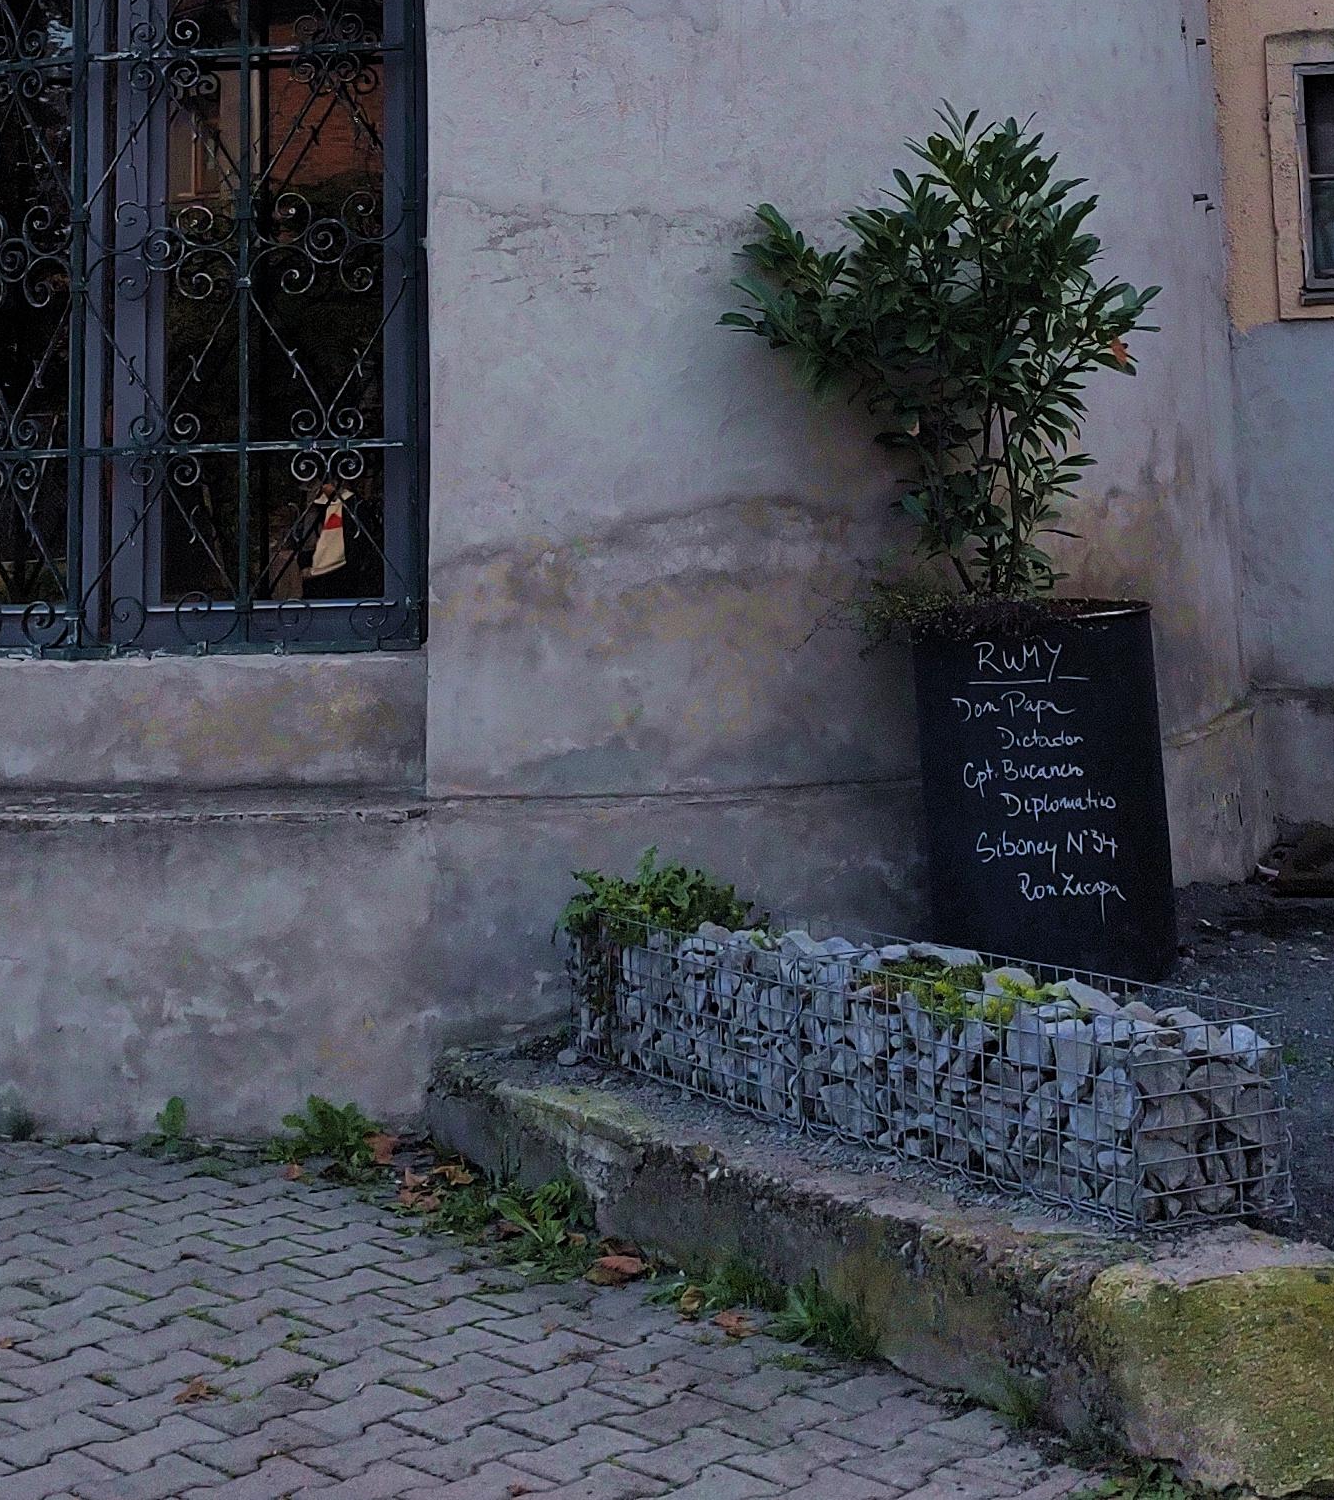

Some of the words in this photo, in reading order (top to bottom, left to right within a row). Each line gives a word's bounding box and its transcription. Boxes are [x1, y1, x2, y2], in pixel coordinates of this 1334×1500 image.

[973, 638, 1062, 683] RUMY
[952, 697, 1000, 722] Don
[1001, 691, 1076, 724] Papa
[976, 830, 1058, 874] Siboney
[1017, 872, 1058, 901] Ron
